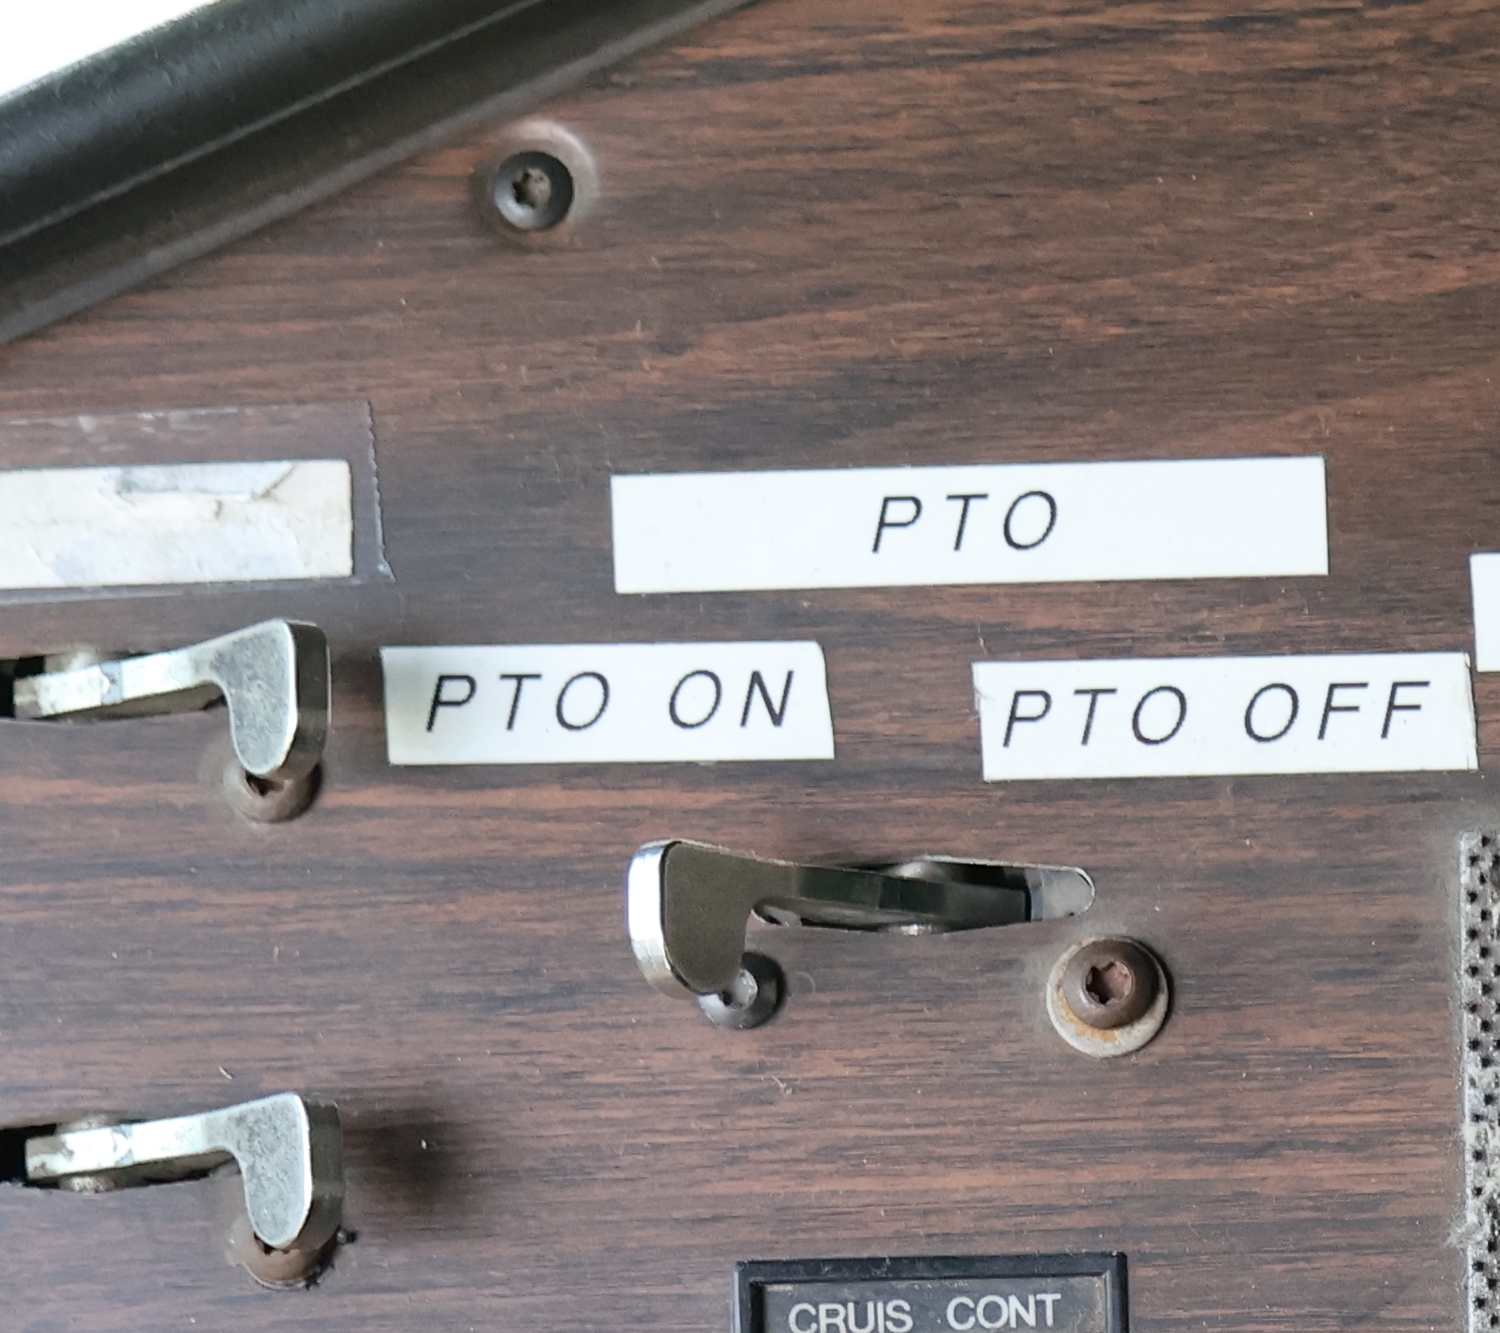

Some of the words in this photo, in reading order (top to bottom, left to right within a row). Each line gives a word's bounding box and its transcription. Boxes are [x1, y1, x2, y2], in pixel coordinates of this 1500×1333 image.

[871, 490, 1060, 553] PTO
[425, 670, 611, 733] PTO
[667, 668, 796, 729] ON
[1002, 684, 1188, 748] PTO
[1242, 680, 1431, 743] OFF
[946, 1292, 1062, 1332] CONT
